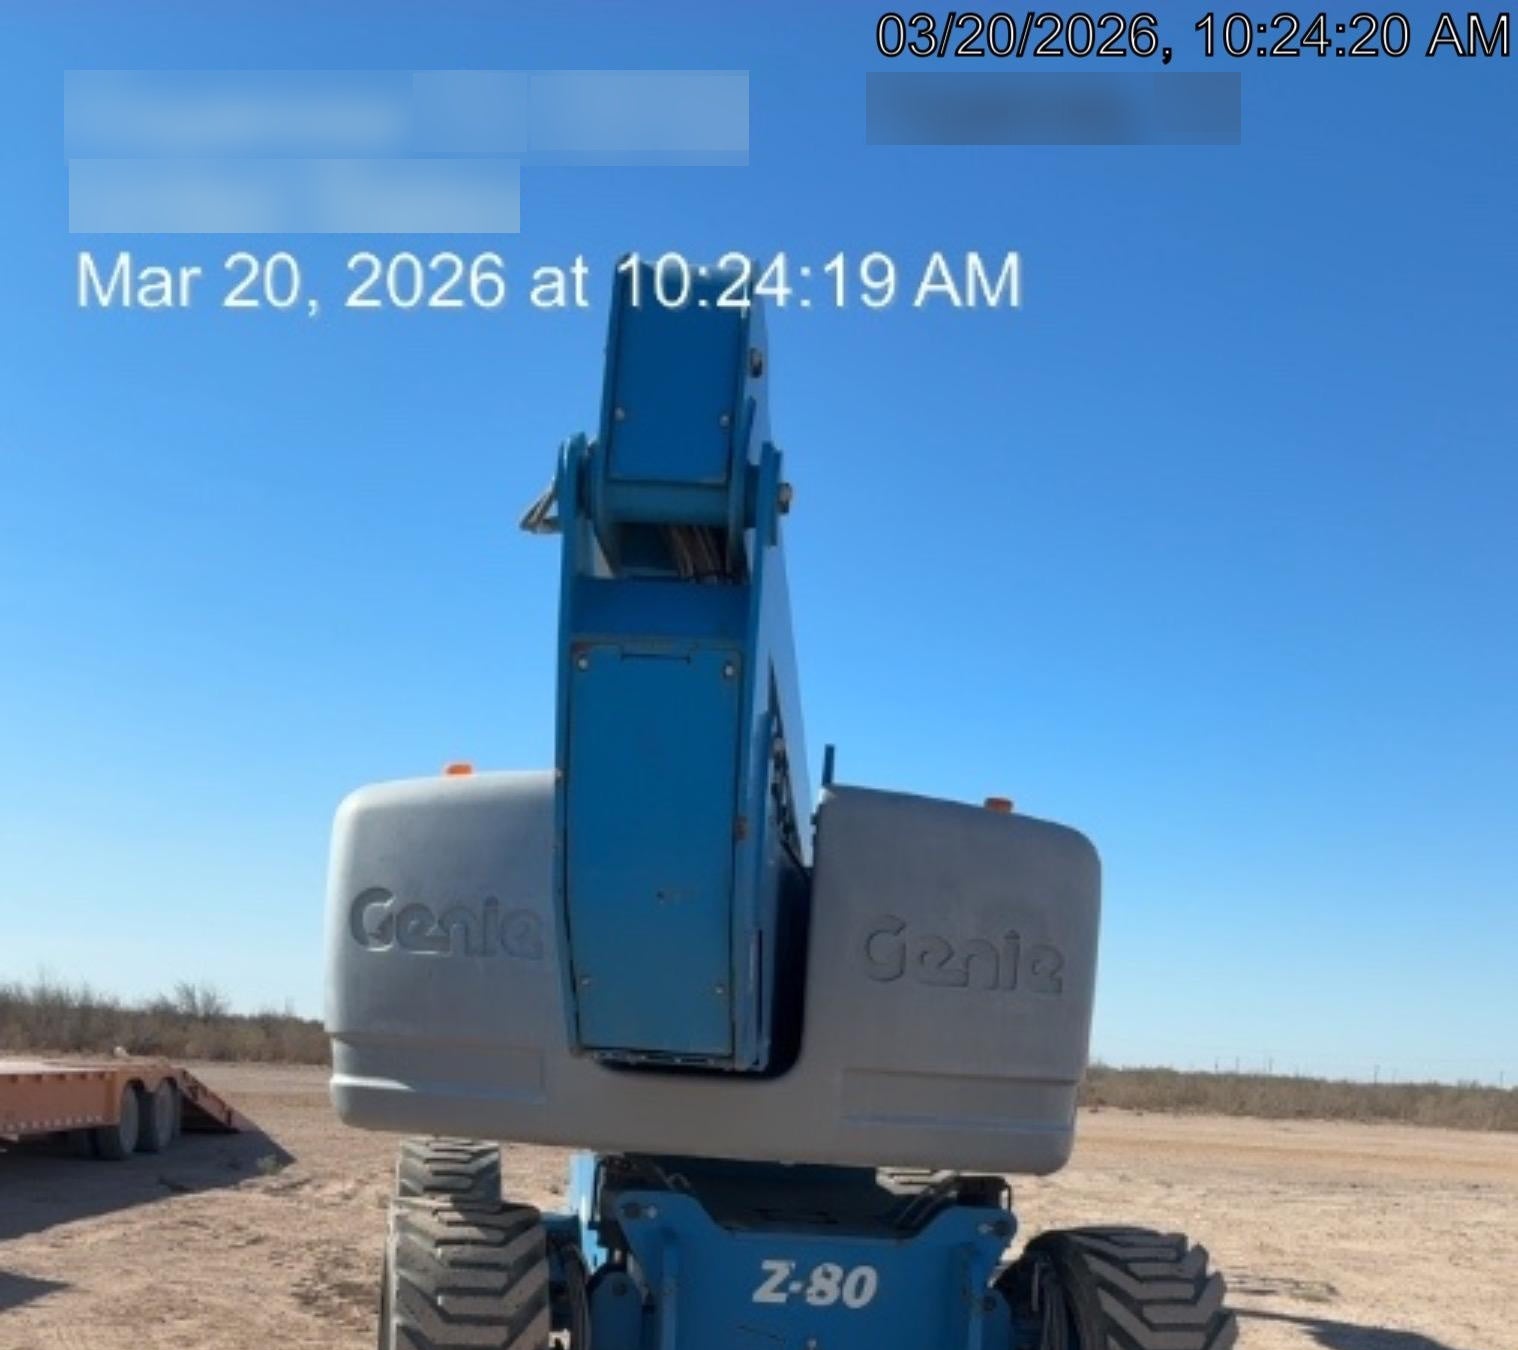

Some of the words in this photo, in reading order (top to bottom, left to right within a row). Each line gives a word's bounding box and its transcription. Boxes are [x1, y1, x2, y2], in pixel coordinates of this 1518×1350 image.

[348, 886, 545, 960] Genie
[864, 914, 1066, 996] Genie
[752, 1258, 878, 1310] Z-80
